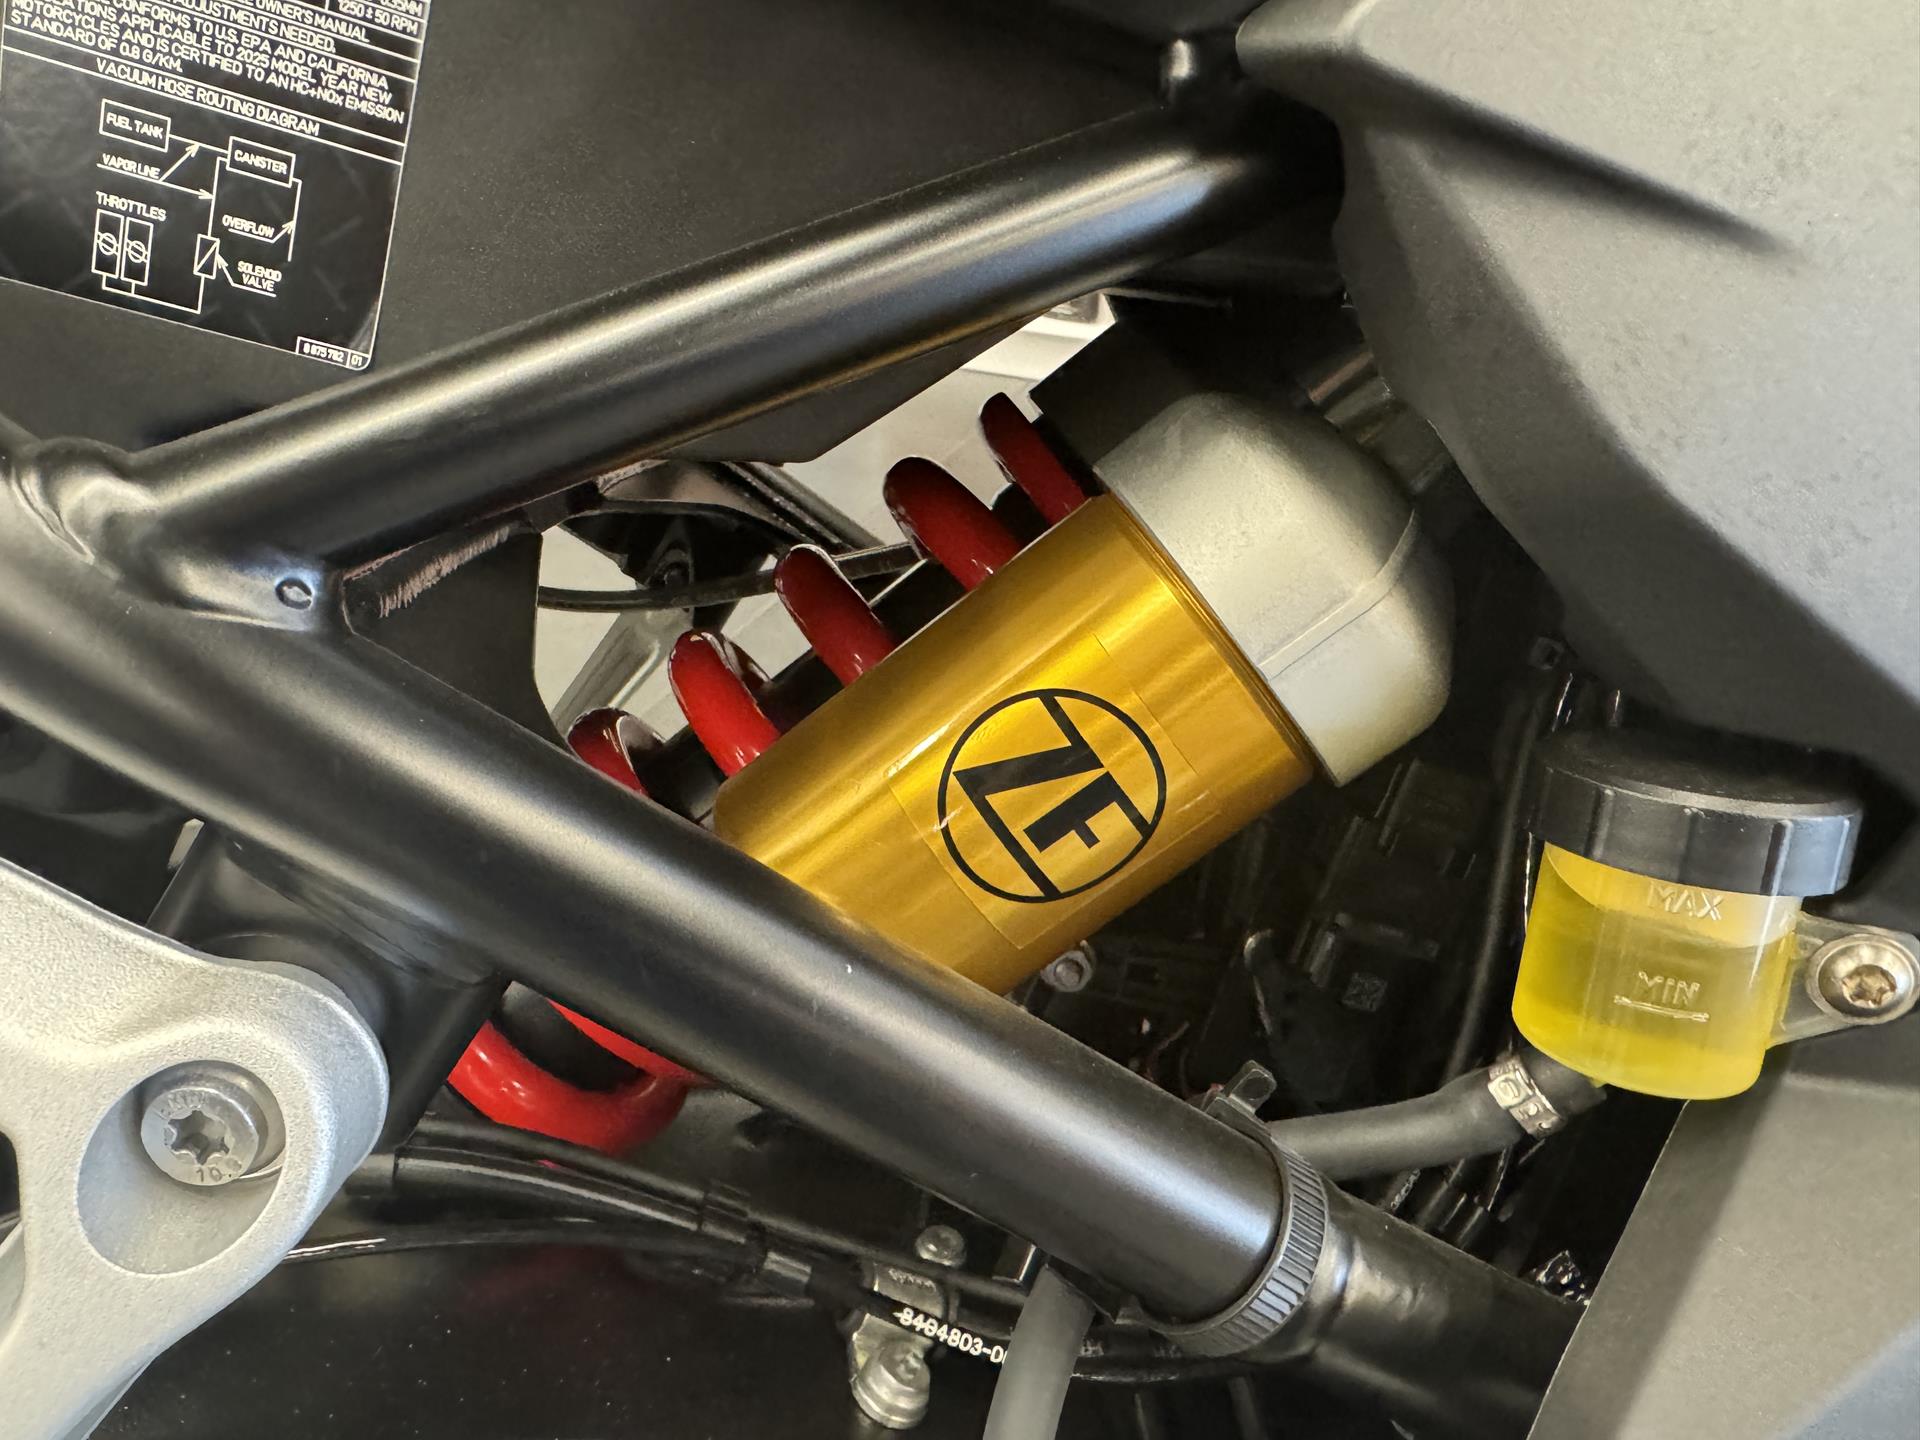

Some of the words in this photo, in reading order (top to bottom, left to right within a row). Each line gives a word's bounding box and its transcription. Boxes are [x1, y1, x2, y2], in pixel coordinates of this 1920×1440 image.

[11, 9, 96, 46] STANDARD
[97, 35, 118, 51] OF
[256, 0, 313, 24] OWNER'S
[314, 13, 370, 42] MANUAL
[375, 9, 390, 25] 50
[391, 14, 419, 35] RPM
[12, 0, 120, 38] MOTORCYCLES
[122, 28, 155, 48] AND
[156, 37, 170, 53] IS
[171, 42, 243, 75] CERTIFIED
[245, 63, 265, 81] TO
[265, 72, 289, 90] AN
[345, 96, 405, 124] EMISSION
[114, 0, 191, 29] CONFORMS
[193, 18, 213, 35] TO
[241, 32, 271, 54] EPA
[274, 44, 306, 63] AND
[307, 54, 388, 90] CALIFORNIA
[119, 12, 212, 50] APPLICABLE
[214, 39, 234, 57] TO
[235, 47, 270, 68] 2025
[271, 57, 317, 83] MODEL
[320, 71, 358, 95] YEAR
[360, 84, 392, 105] NEW
[96, 57, 156, 88] VACUUM
[158, 76, 195, 100] HOSE
[196, 87, 255, 117] ROUTING
[255, 105, 320, 136] DIAGRAM
[106, 112, 132, 131] FUEL
[134, 119, 163, 139] TANK
[102, 153, 136, 173] VAPOR
[138, 163, 160, 179] LINE
[234, 149, 288, 175] CANISTER
[95, 190, 167, 222] THROTTLES
[222, 214, 275, 238] OVERFLOW
[242, 273, 275, 292] VALVE
[945, 692, 1157, 899] ZF
[1646, 880, 1723, 921] MAX
[1635, 971, 1700, 1006] MIN
